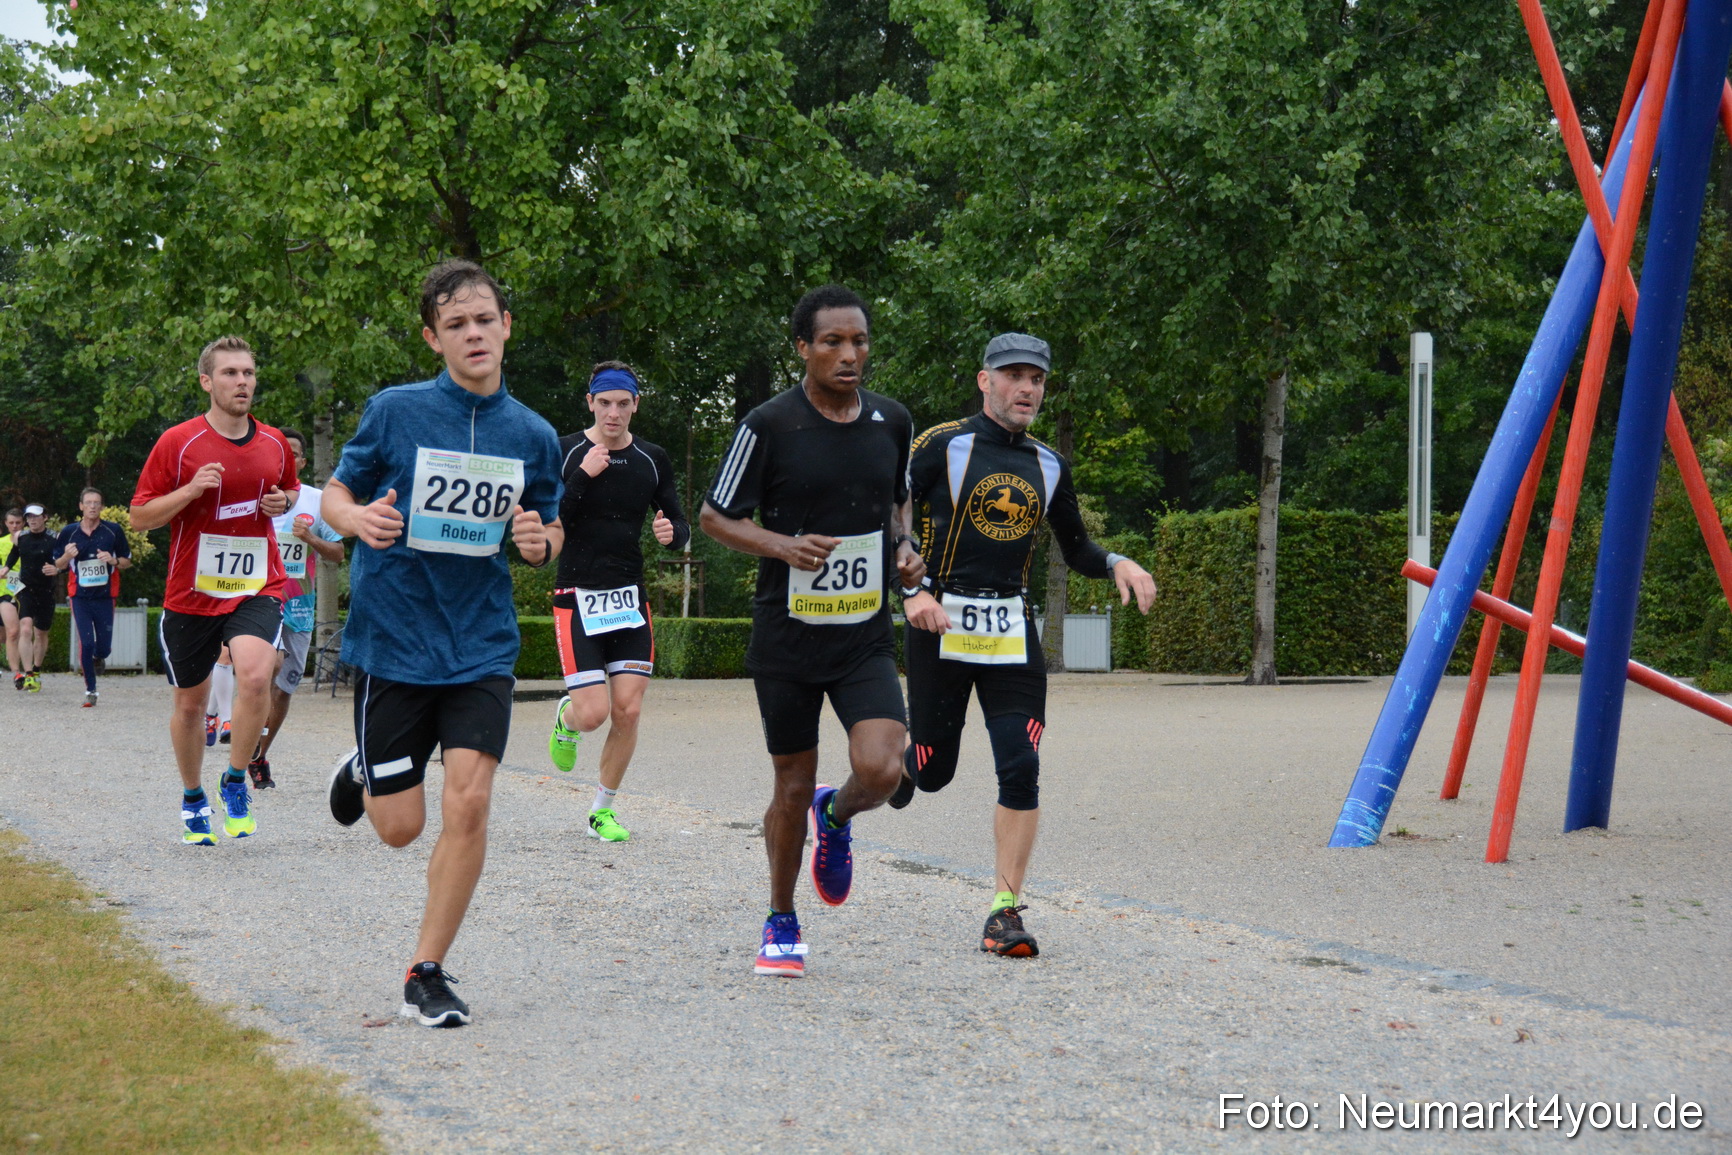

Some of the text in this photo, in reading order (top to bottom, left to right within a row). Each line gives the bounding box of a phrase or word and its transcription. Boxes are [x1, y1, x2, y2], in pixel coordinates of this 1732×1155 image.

[469, 457, 515, 475] BOCK
[424, 475, 514, 518] 2286
[975, 475, 1038, 506] CONTINENTAL
[441, 523, 487, 542] Robert
[971, 508, 1033, 538] CONTINENTAL
[278, 543, 303, 561] 78
[81, 565, 105, 577] 2580
[214, 551, 255, 576] 170
[811, 556, 868, 592] 236
[216, 580, 246, 591] Martin
[585, 589, 635, 615] 2790
[795, 597, 877, 614] Girma Ayalew
[599, 614, 631, 626] Thomas
[961, 604, 1011, 634] 618
[962, 637, 998, 651] Hubert
